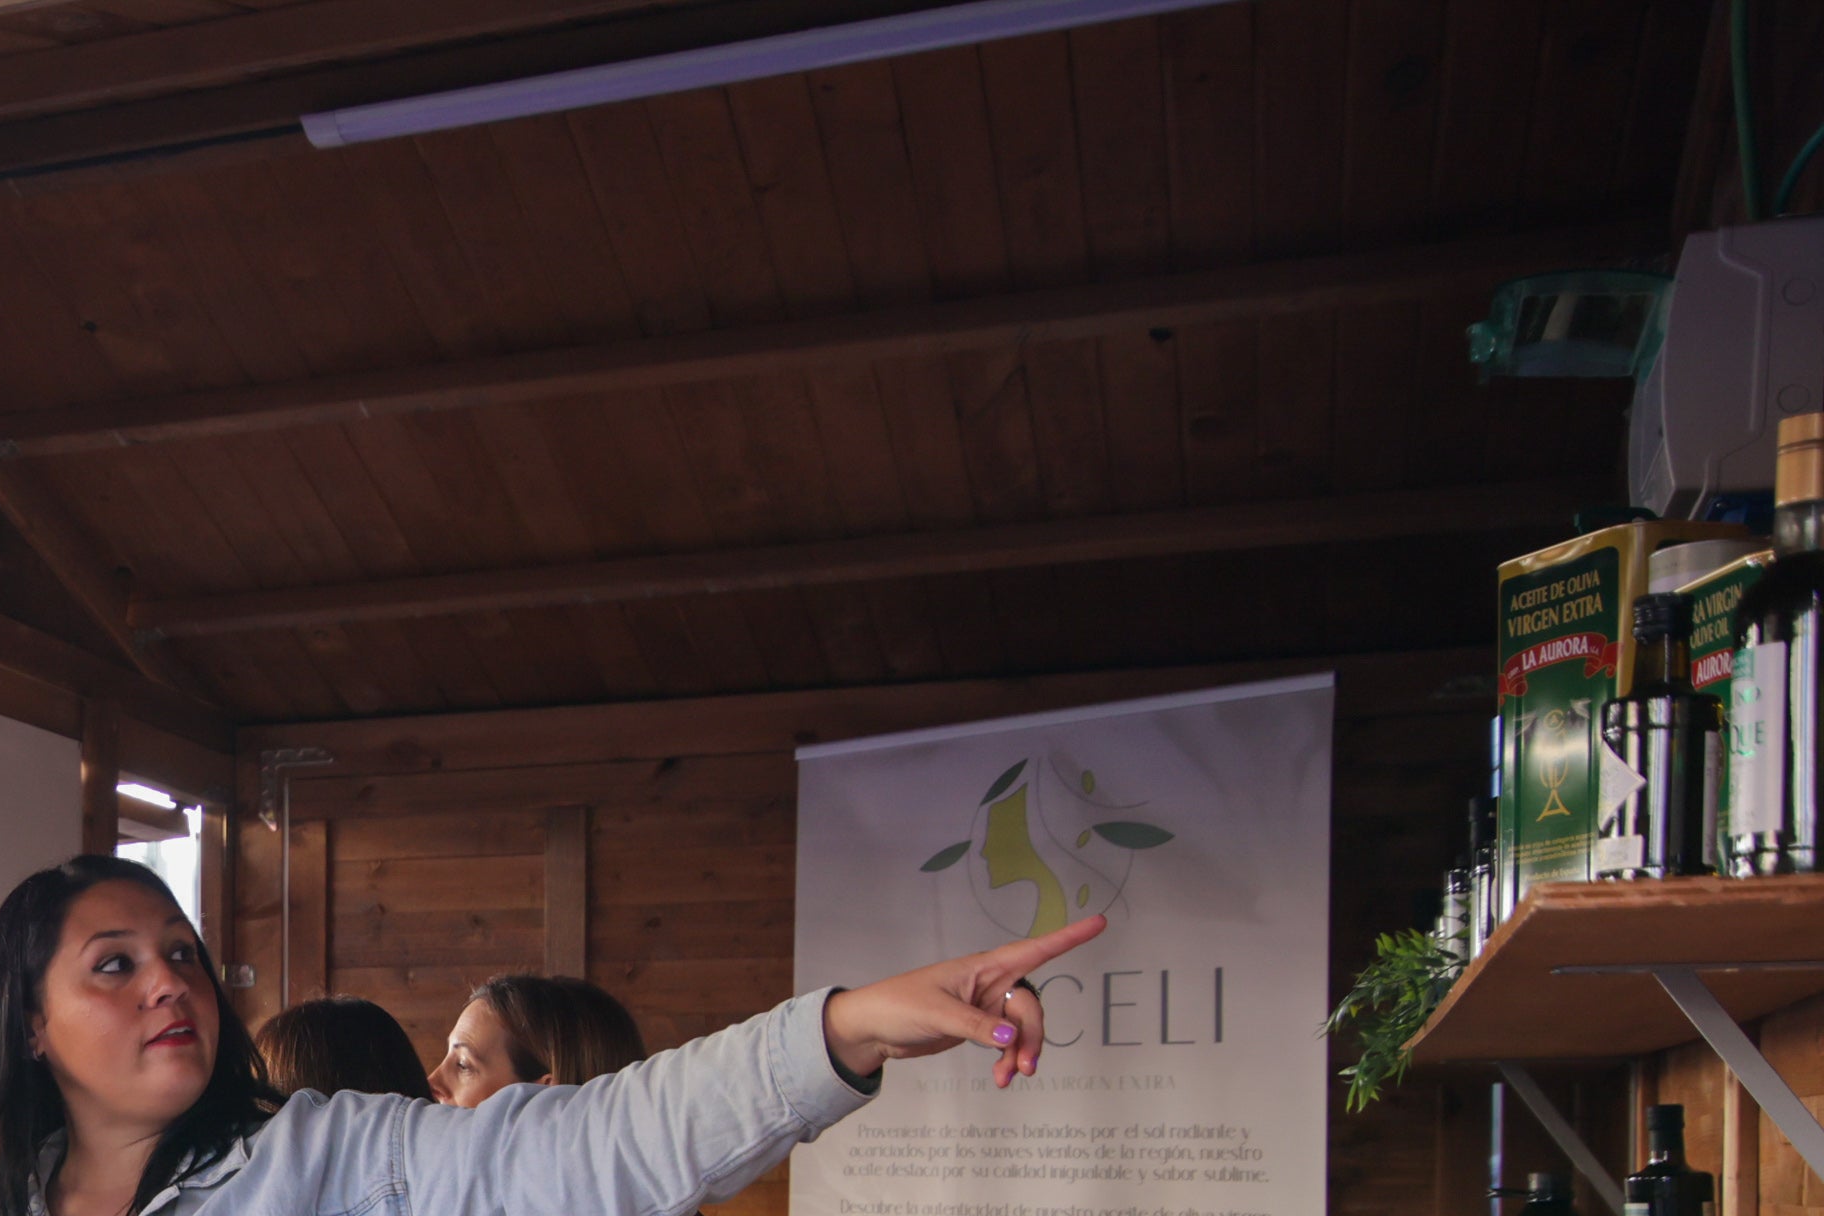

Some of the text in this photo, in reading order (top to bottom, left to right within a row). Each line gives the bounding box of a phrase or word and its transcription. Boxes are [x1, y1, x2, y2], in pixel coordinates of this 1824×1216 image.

[1510, 569, 1601, 612] ACEITE DE OLIVA
[1706, 582, 1743, 618] VIRGIN
[1508, 592, 1604, 638] VIRGEN EXTRA
[1521, 650, 1537, 671] LA
[1538, 635, 1589, 665] AURORA
[1696, 652, 1732, 685] AUROR
[857, 1122, 1252, 1144] Proveniente de olivares bañados por el sol radiante y
[848, 1144, 925, 1159] acariciados
[928, 1145, 951, 1162] por
[955, 1143, 976, 1159] los
[980, 1147, 1034, 1160] suaves
[1037, 1144, 1090, 1160] vientos
[1094, 1144, 1118, 1160] de
[1120, 1144, 1135, 1160] la
[1199, 1143, 1264, 1161] nuestro
[842, 1163, 1270, 1185] aceite destaca por su calidad inigualable y sabor sublime.
[840, 1198, 904, 1216] Descubre
[906, 1200, 919, 1216] la
